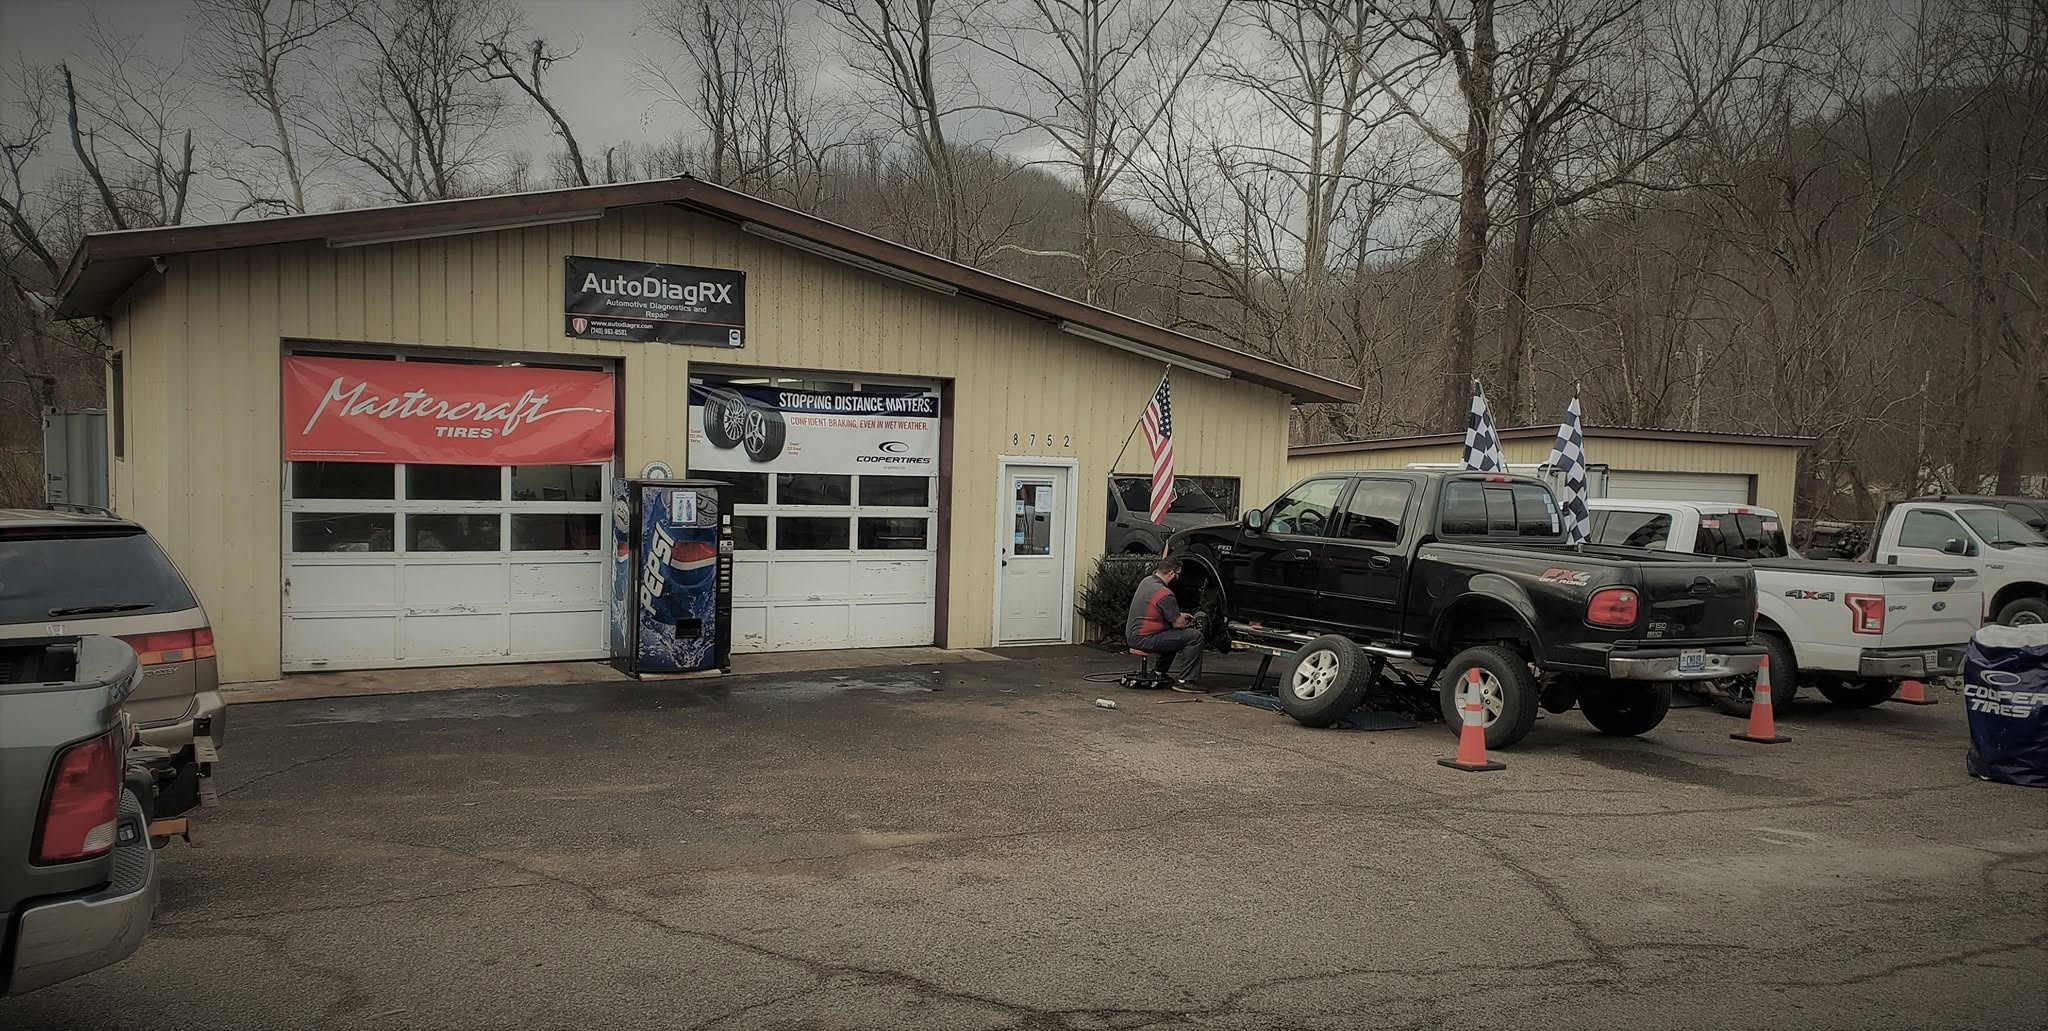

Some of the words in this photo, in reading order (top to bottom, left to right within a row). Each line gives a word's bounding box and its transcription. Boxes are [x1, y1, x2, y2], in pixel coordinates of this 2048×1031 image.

[581, 272, 733, 306] AutoDiagRX
[606, 299, 648, 309] Automotive
[650, 302, 692, 312] Diagnostics
[693, 305, 707, 313] and
[645, 311, 669, 319] Repair
[302, 376, 606, 437] Mastercraft
[779, 392, 832, 410] STOPPING
[834, 395, 885, 412] DISTANCE
[885, 397, 933, 413] MATTERS.
[790, 416, 827, 427] CONFIDENT
[829, 418, 859, 429] BRAKING,
[859, 420, 876, 429] EVEN
[876, 420, 883, 429] IN
[884, 420, 897, 430] WET
[897, 421, 929, 431] WEATHER.
[641, 521, 675, 617] PEPSI
[1540, 568, 1591, 581] FX4
[1558, 579, 1588, 587] ROAD
[1964, 683, 2048, 706] COOPER
[1971, 698, 2033, 719] TIRES
